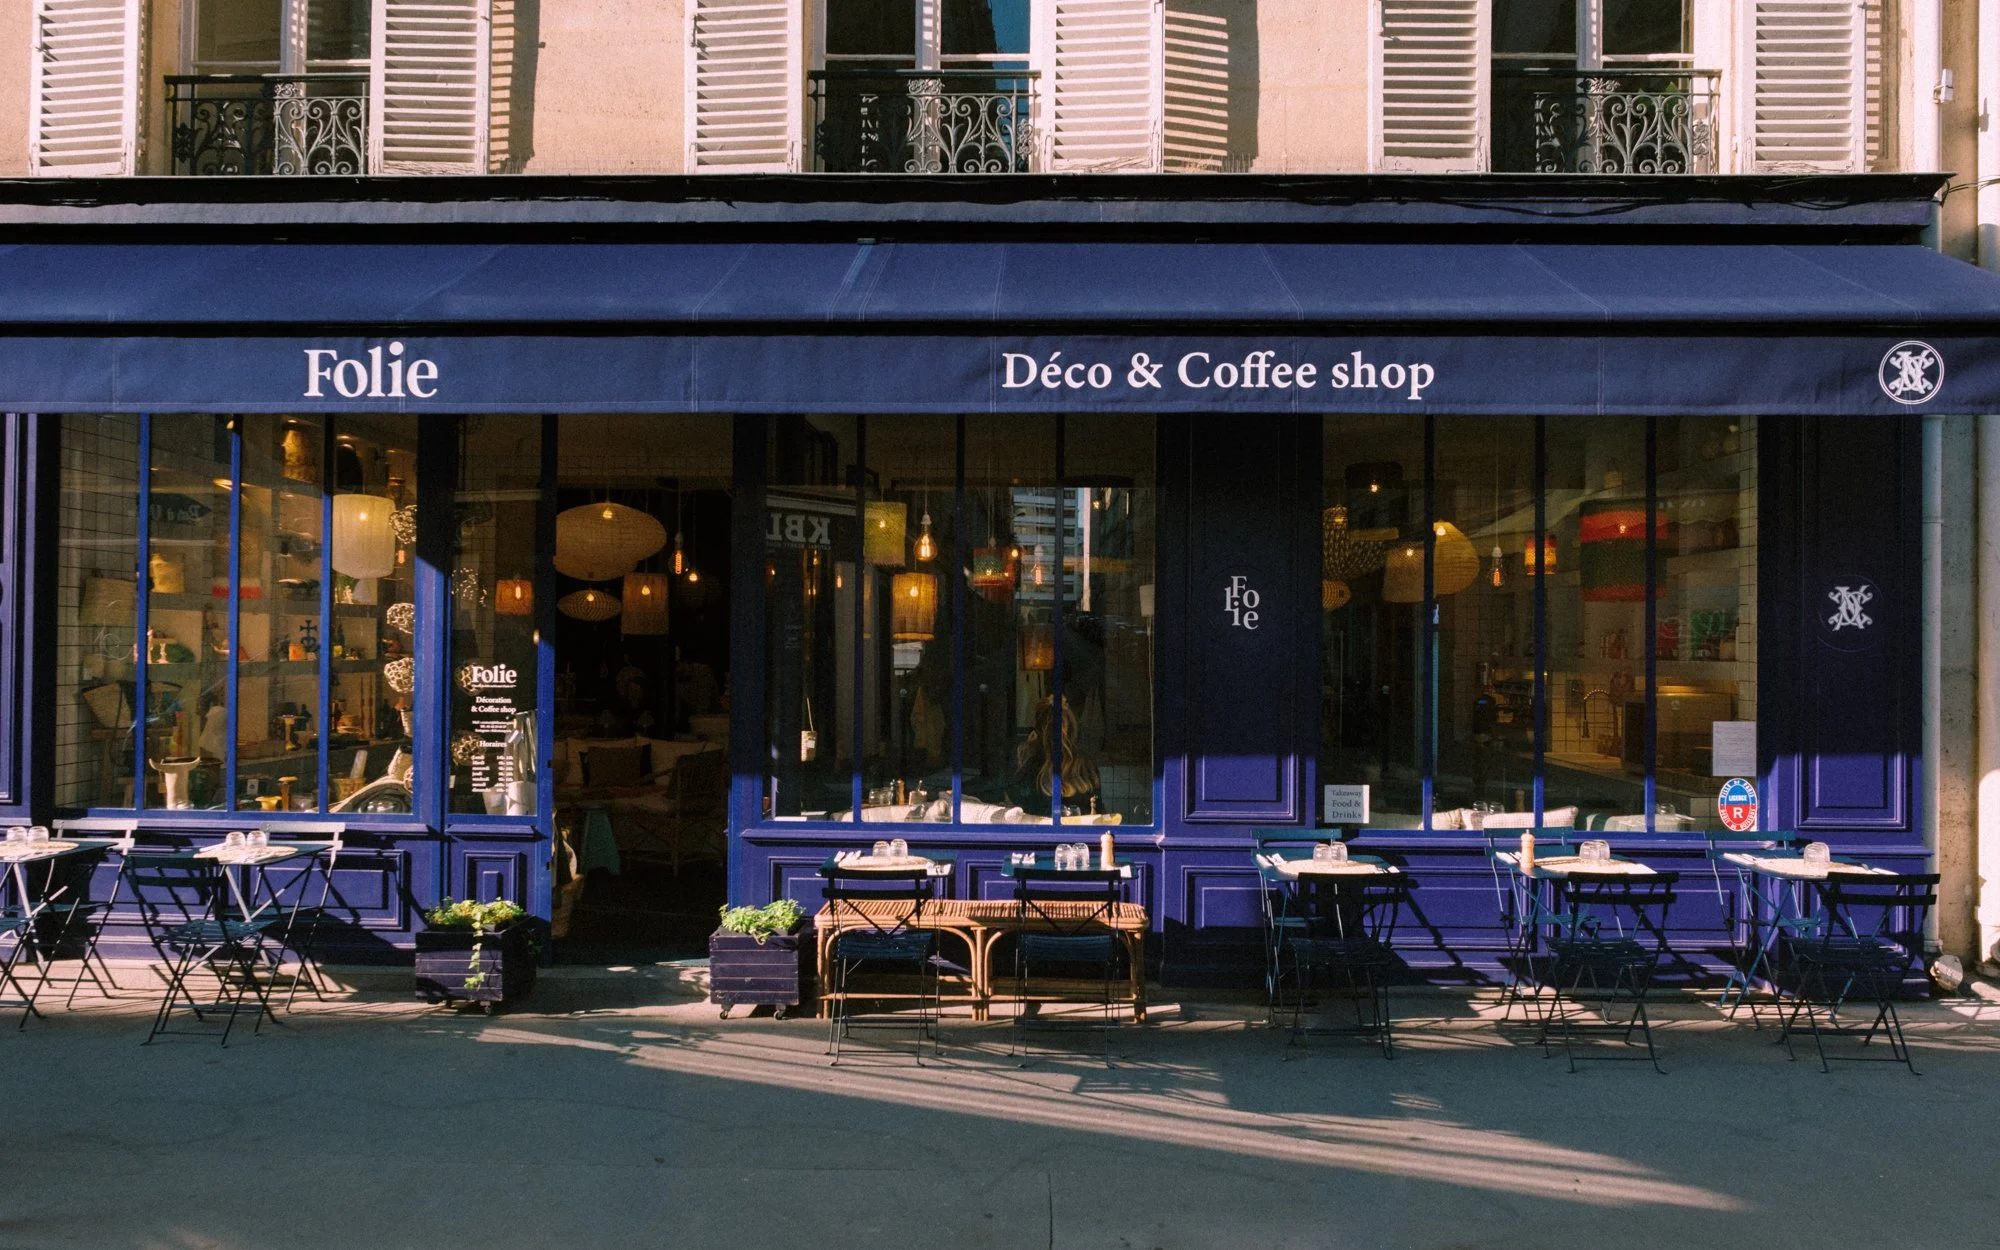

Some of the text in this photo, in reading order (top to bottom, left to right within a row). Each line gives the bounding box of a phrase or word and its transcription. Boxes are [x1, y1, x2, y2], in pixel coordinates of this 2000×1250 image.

[303, 341, 439, 398] Folie
[1002, 351, 1435, 400] Déco & Coffee shop
[472, 664, 517, 684] Folie
[476, 696, 512, 704] Décoration
[478, 705, 499, 713] Coffee
[500, 706, 517, 715] shop
[1331, 790, 1362, 798] Takeaway
[1332, 800, 1352, 808] Food
[1332, 811, 1362, 819] Drinks
[1733, 807, 1743, 819] R
